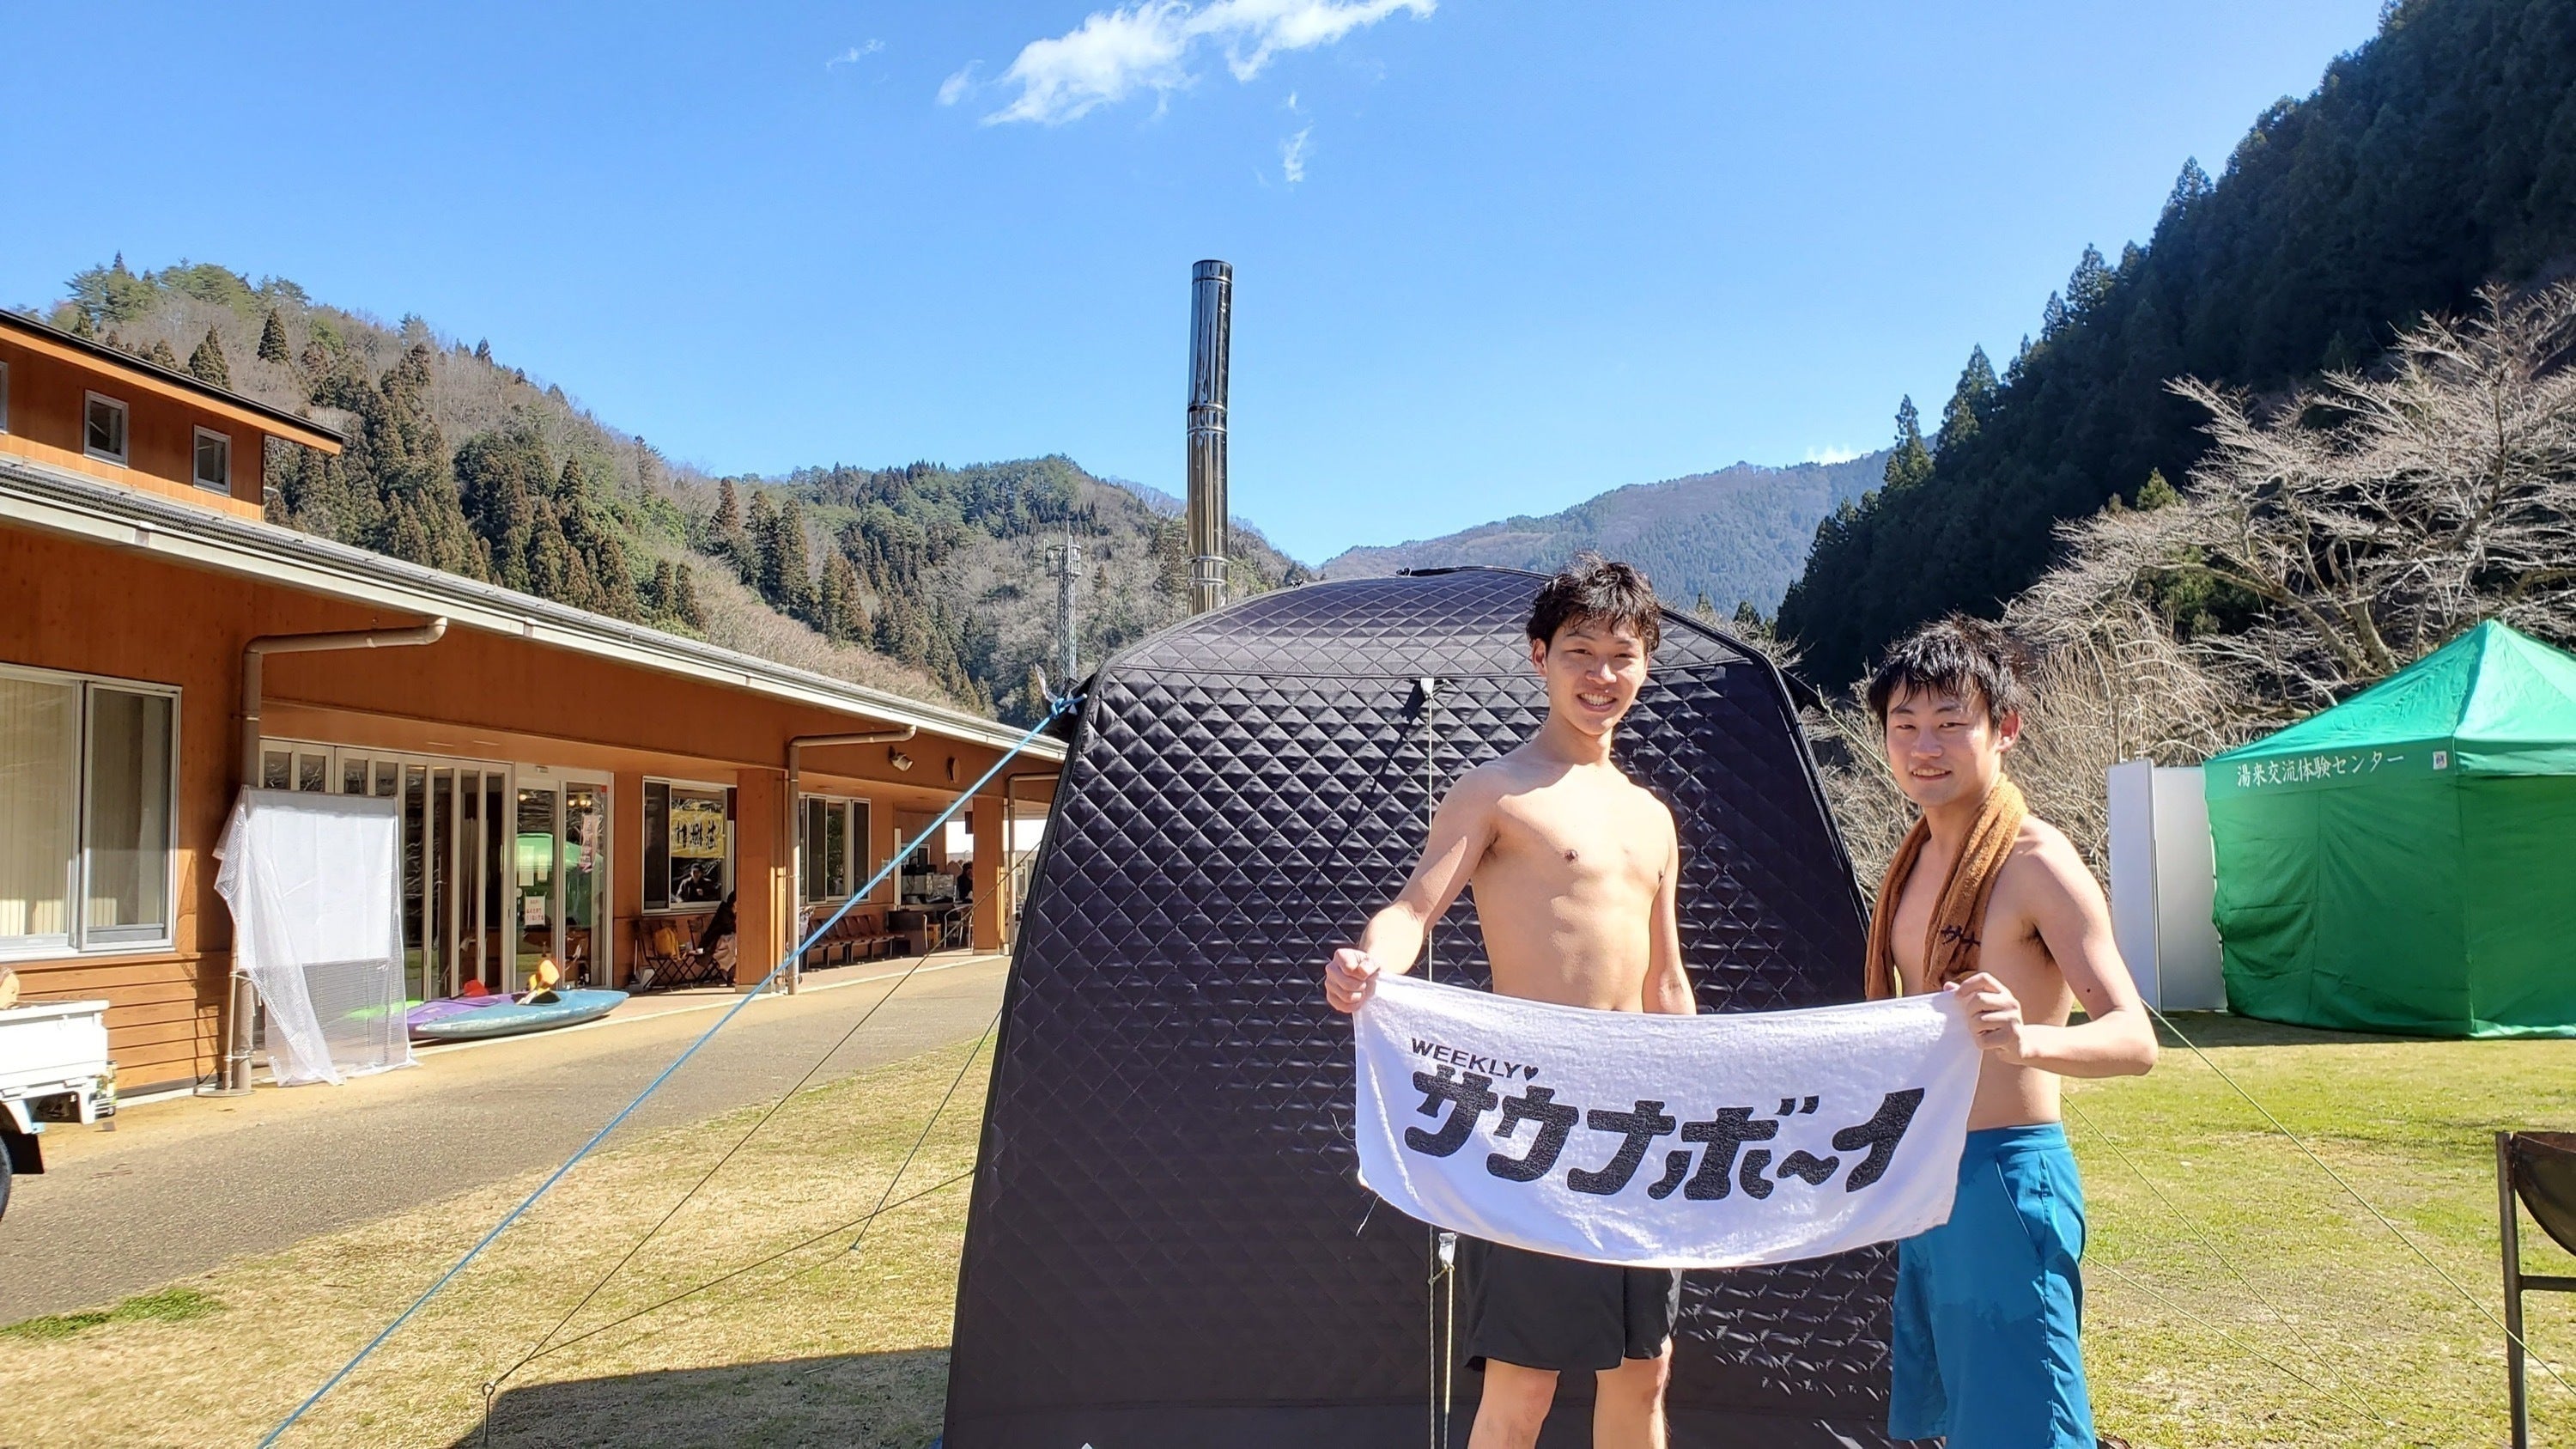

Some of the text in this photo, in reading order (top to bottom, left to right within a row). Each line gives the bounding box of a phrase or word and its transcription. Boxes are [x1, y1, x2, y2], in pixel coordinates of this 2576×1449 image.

[2237, 750, 2404, 788] 湯来交流体験センター
[1411, 1037, 1522, 1079] WEEKLY
